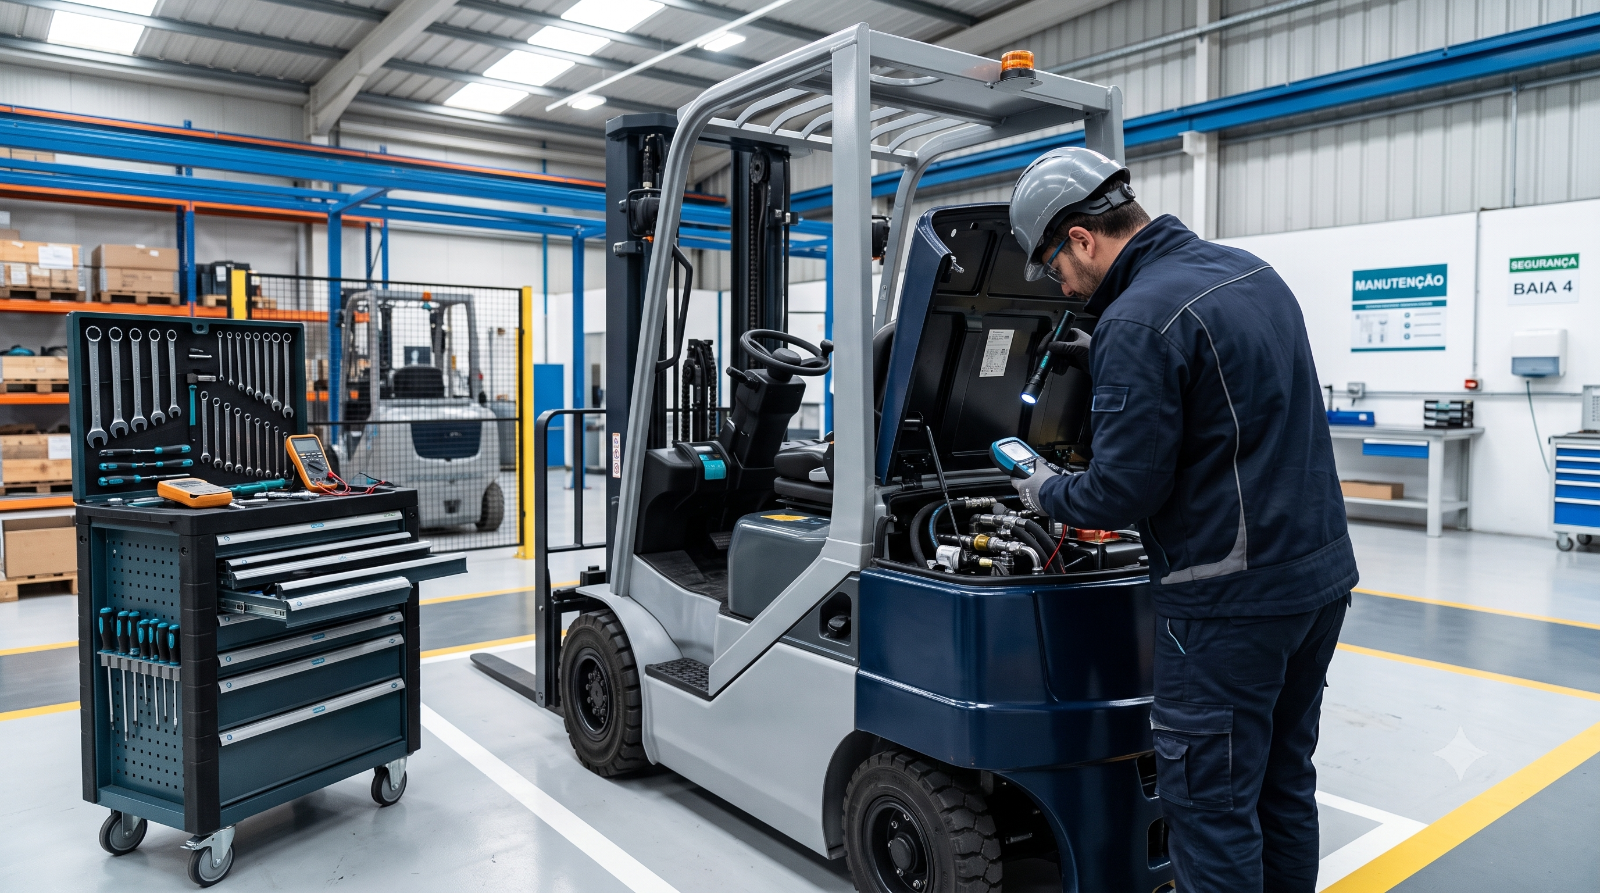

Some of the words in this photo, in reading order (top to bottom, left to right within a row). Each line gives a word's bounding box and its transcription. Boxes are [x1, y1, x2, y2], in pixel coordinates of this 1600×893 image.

[1511, 257, 1577, 270] SEGURANÇA
[1355, 273, 1444, 291] MANUTENÇÃO
[1514, 281, 1557, 295] BAIA
[1563, 280, 1573, 292] 4
